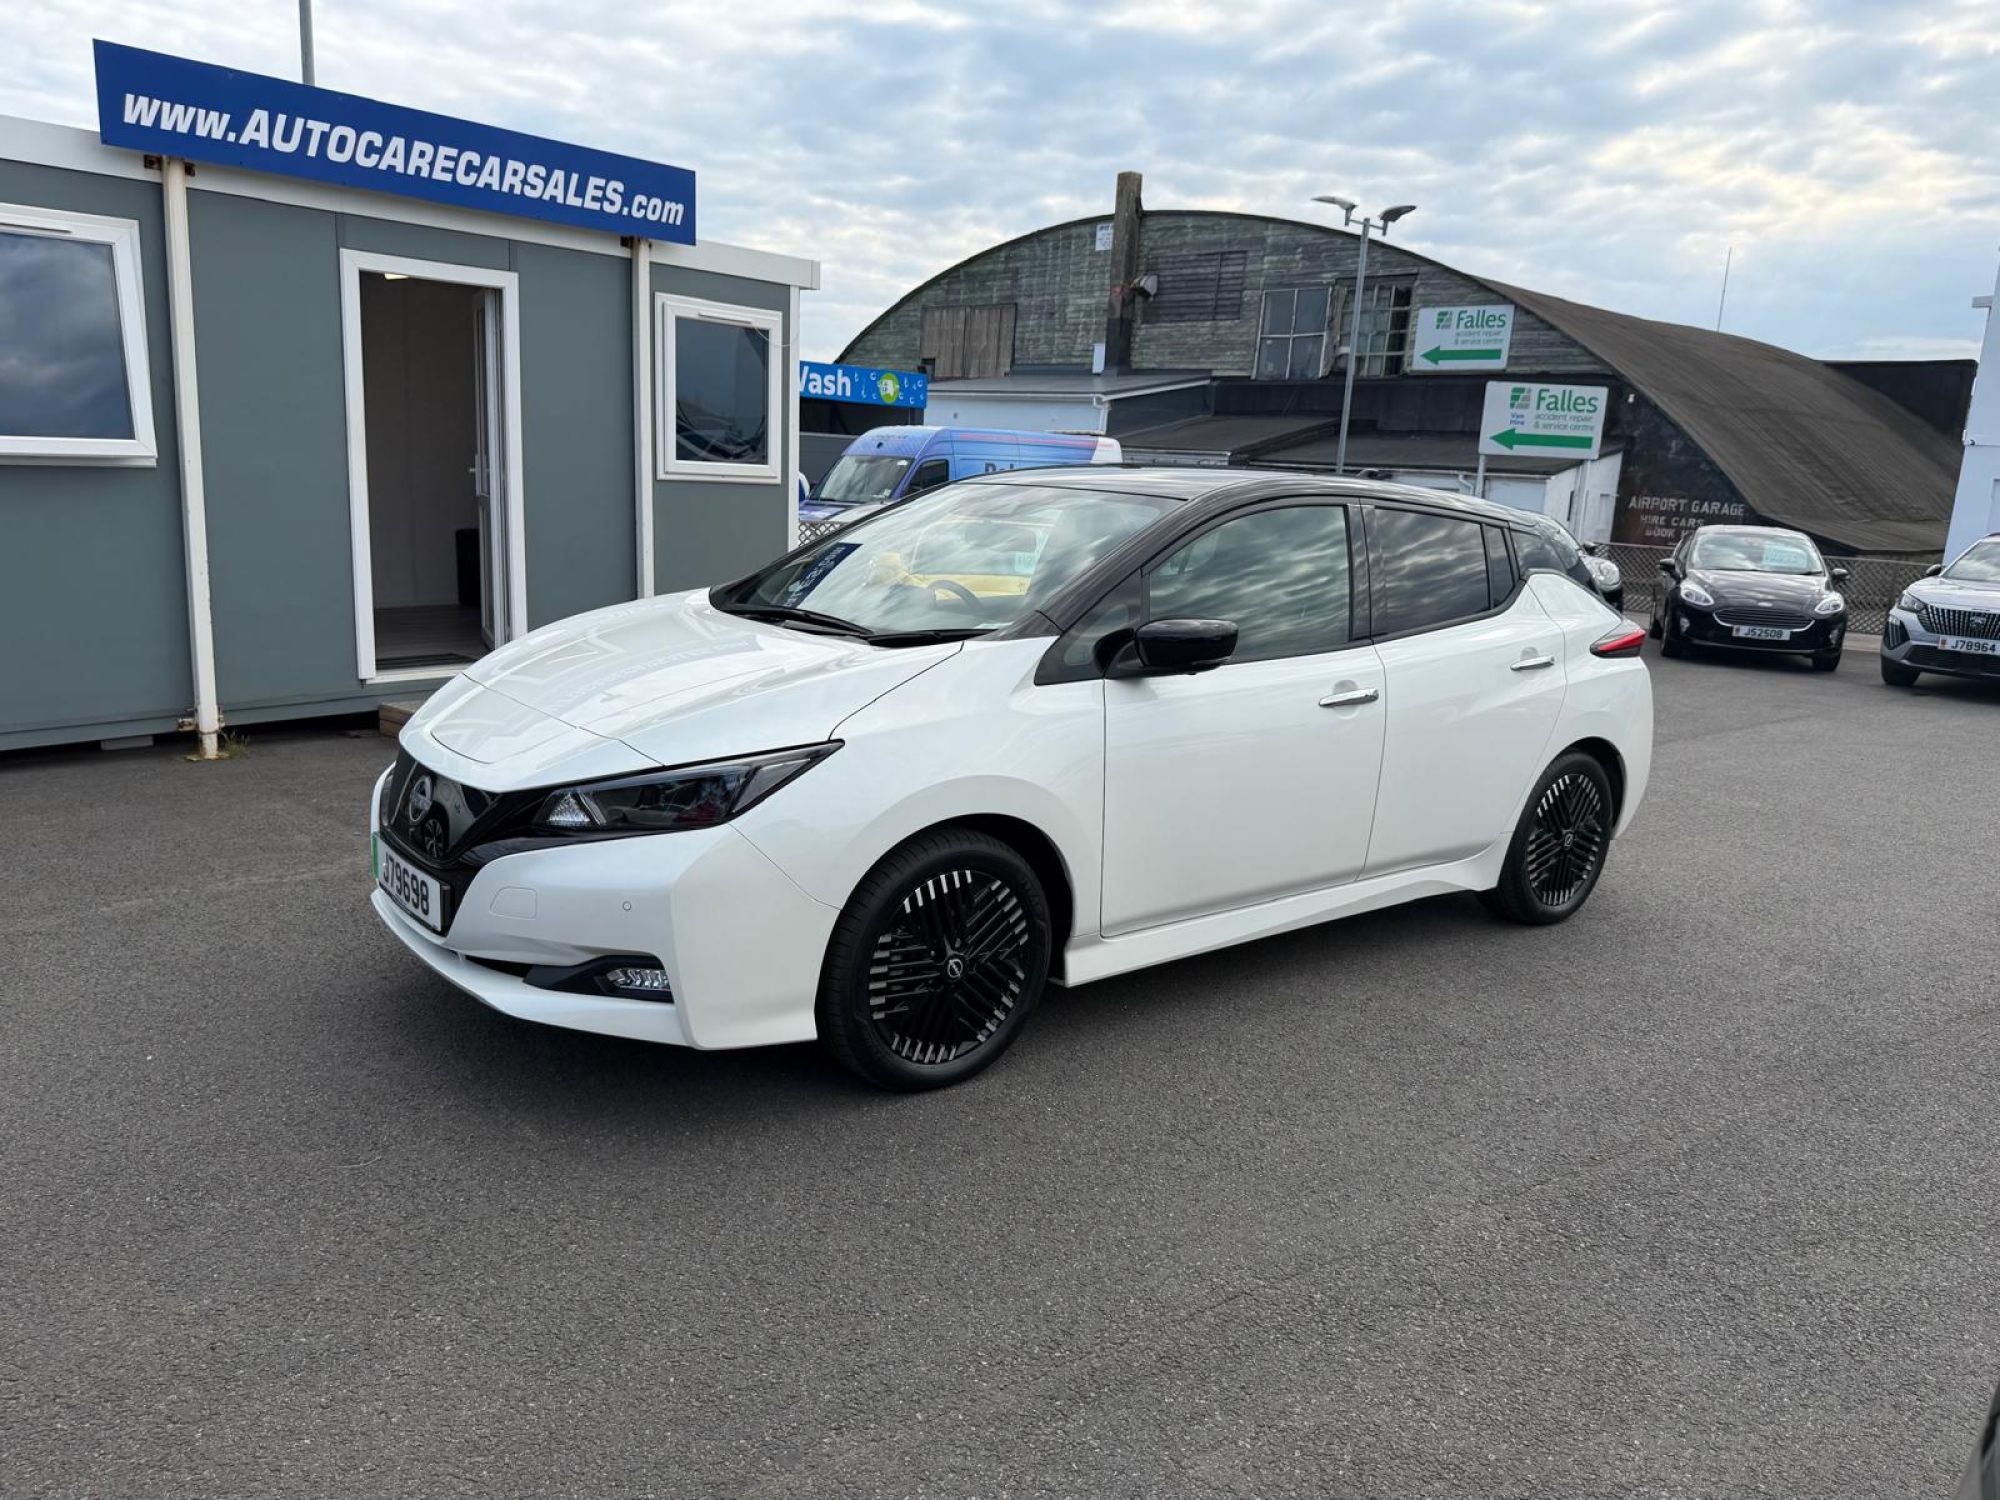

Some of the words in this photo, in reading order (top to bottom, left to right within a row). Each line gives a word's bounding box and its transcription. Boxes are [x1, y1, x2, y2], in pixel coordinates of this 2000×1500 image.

[122, 93, 685, 226] www.AUTOCARECARSALES.com
[1456, 309, 1506, 329] Falles
[1536, 388, 1599, 414] Falles
[1535, 413, 1567, 421] accident
[1569, 415, 1593, 423] repair
[1542, 422, 1569, 431] service
[1570, 424, 1595, 432] centre
[1628, 495, 1688, 512] AIRPORT
[1690, 499, 1746, 517] GARAGE
[1640, 514, 1666, 526] HIRE
[1671, 516, 1705, 528] CARS
[1951, 639, 1997, 653] J78964
[383, 851, 430, 917] J79698
